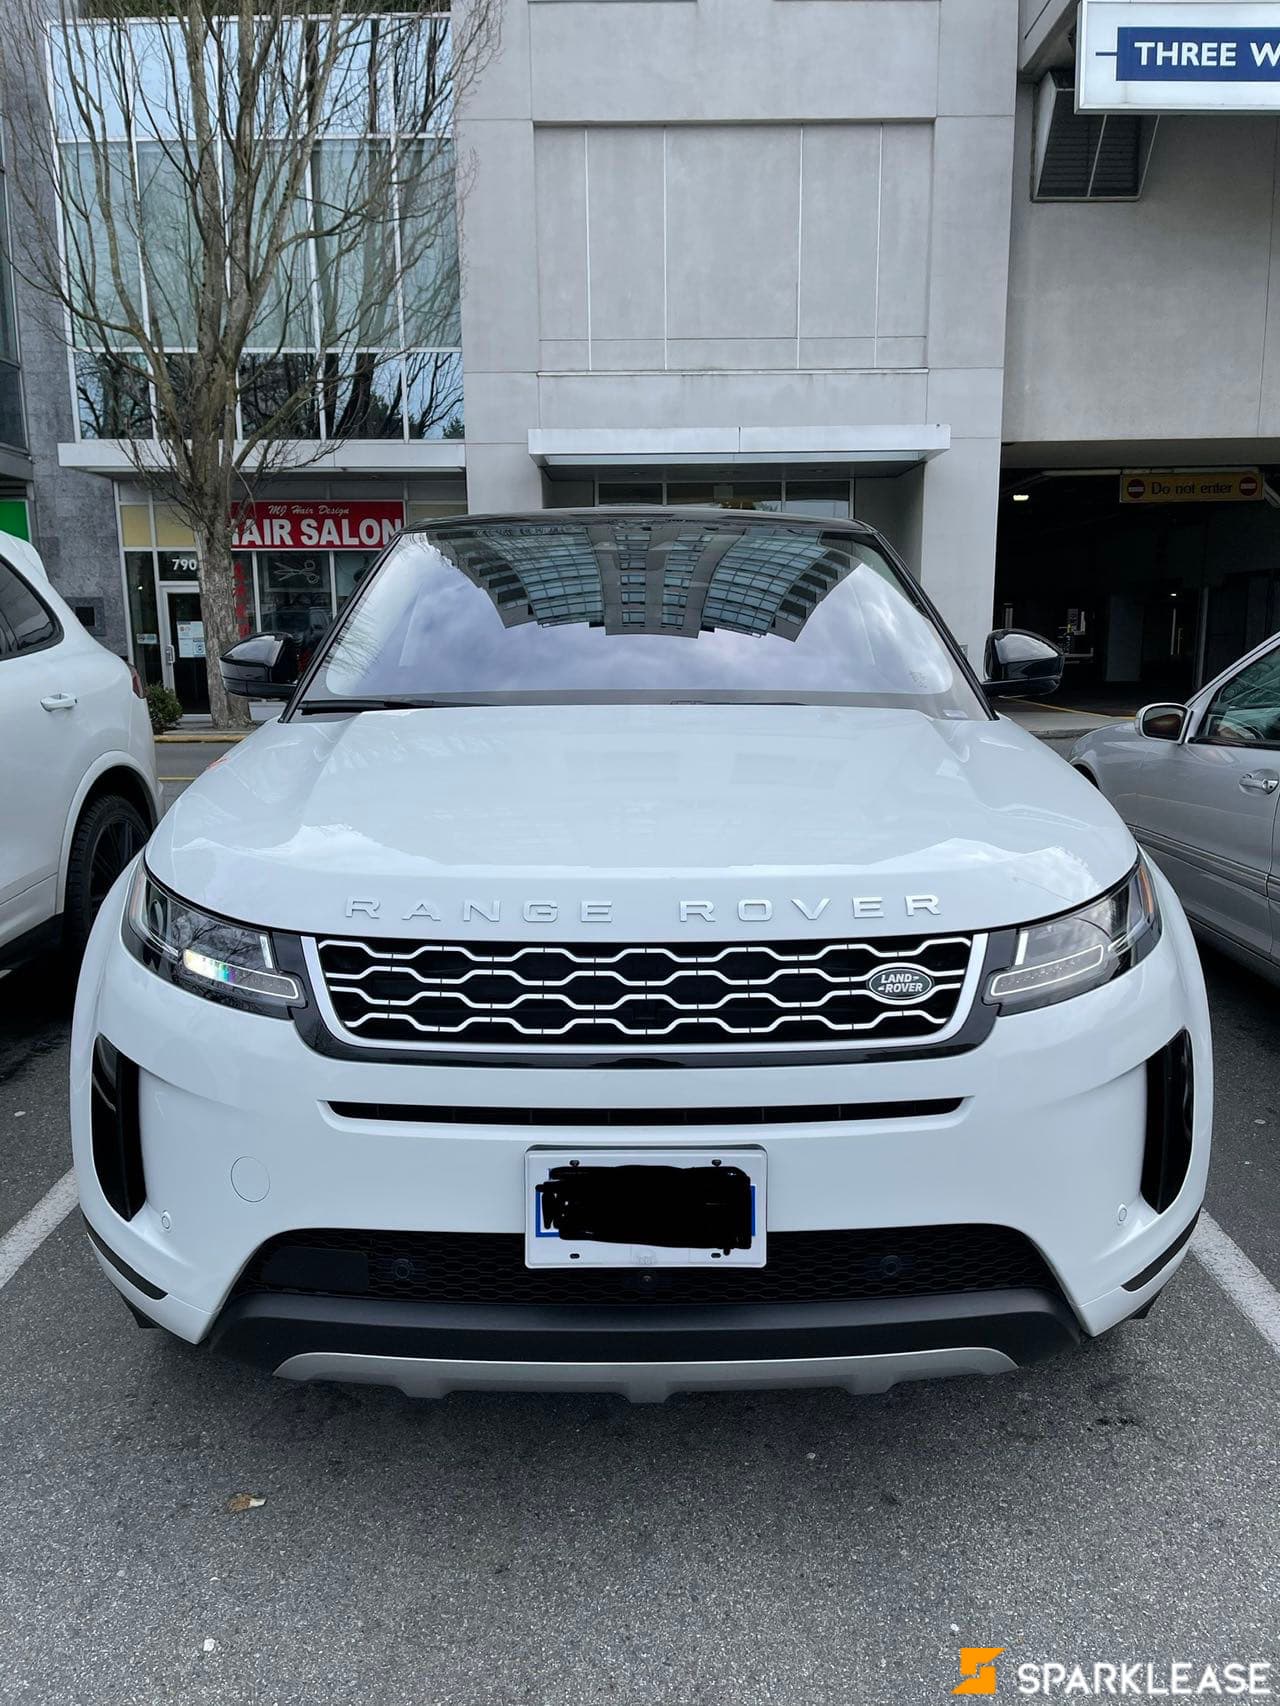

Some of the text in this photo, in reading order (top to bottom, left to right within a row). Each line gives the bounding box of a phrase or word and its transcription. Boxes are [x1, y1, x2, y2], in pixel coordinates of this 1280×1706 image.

[1134, 41, 1237, 66] THREE
[1151, 481, 1233, 495] Do not enter
[268, 504, 350, 517] MJ Hair Design
[300, 518, 401, 546] SALON
[172, 559, 197, 570] 790
[345, 894, 941, 923] RANGE ROVER
[885, 982, 923, 993] ROVER
